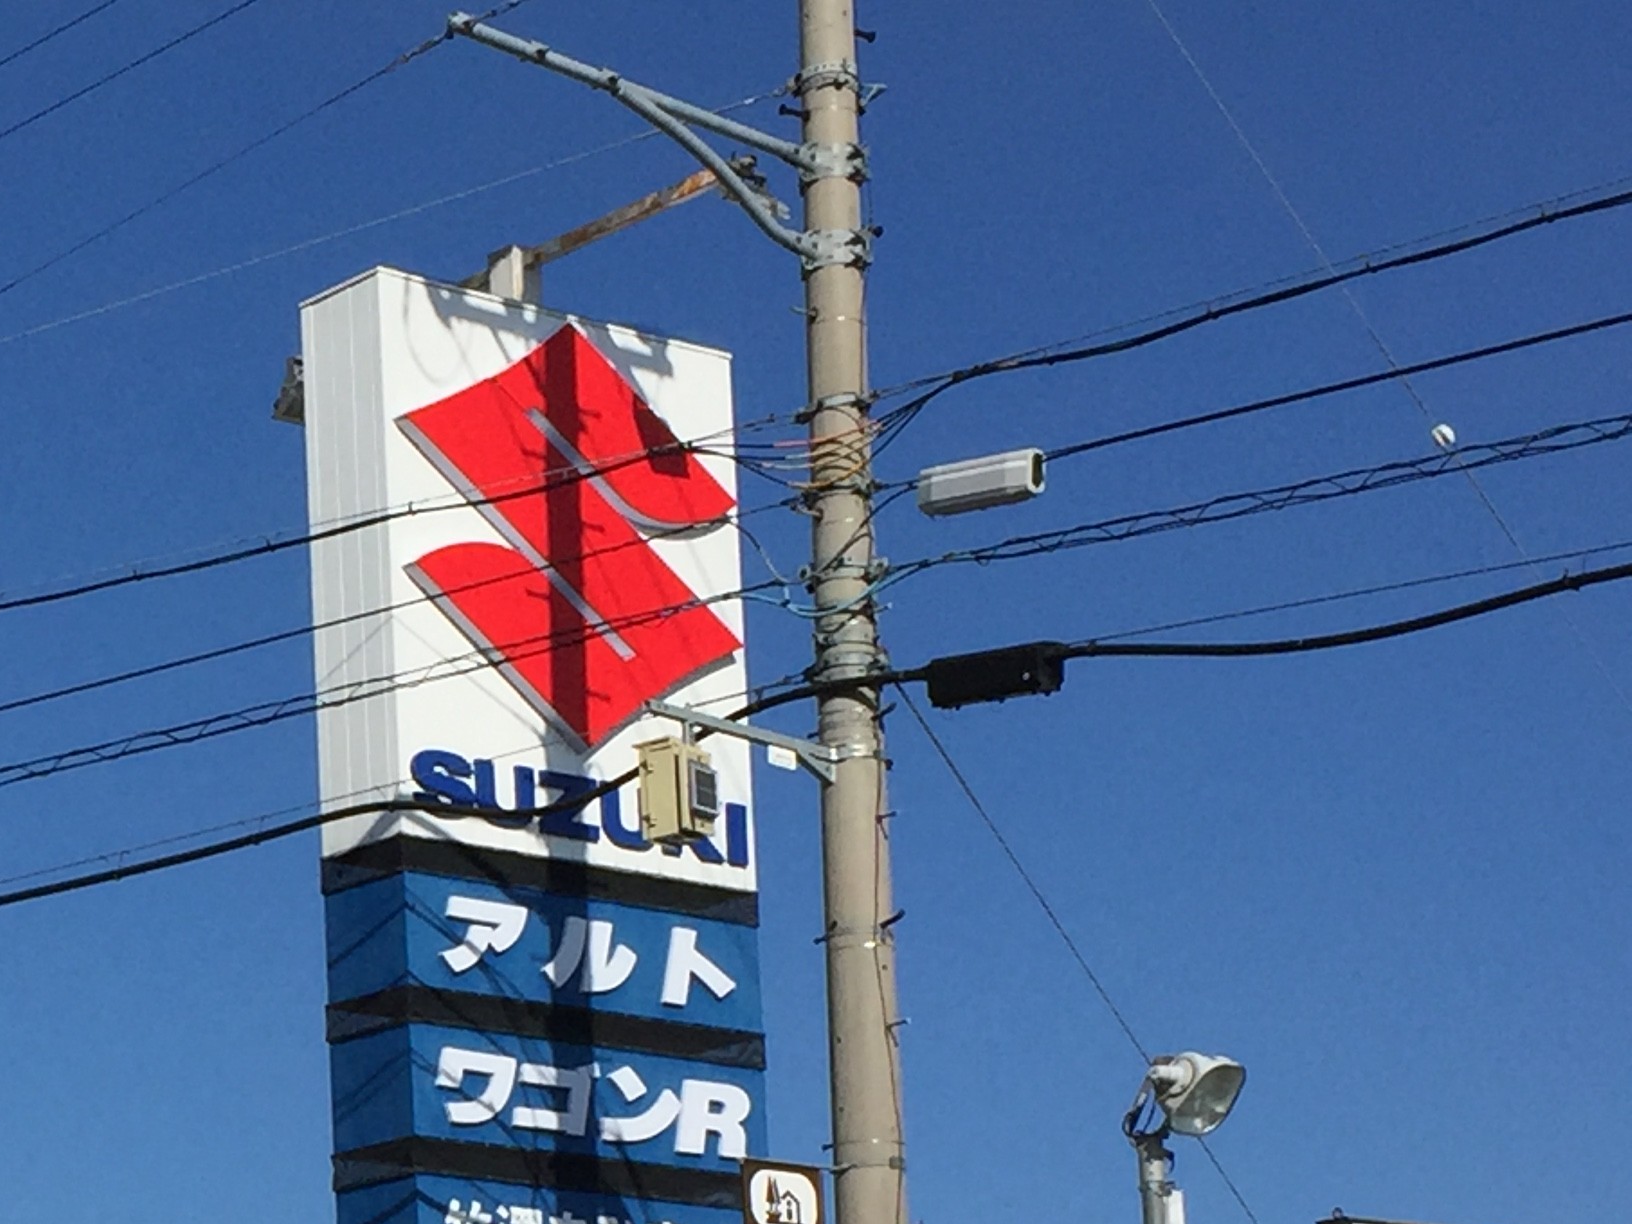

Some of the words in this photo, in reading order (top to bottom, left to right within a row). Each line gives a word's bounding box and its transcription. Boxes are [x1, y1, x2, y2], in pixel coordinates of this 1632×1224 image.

[438, 896, 737, 1006] アルト
[435, 1046, 752, 1159] ワゴンR
